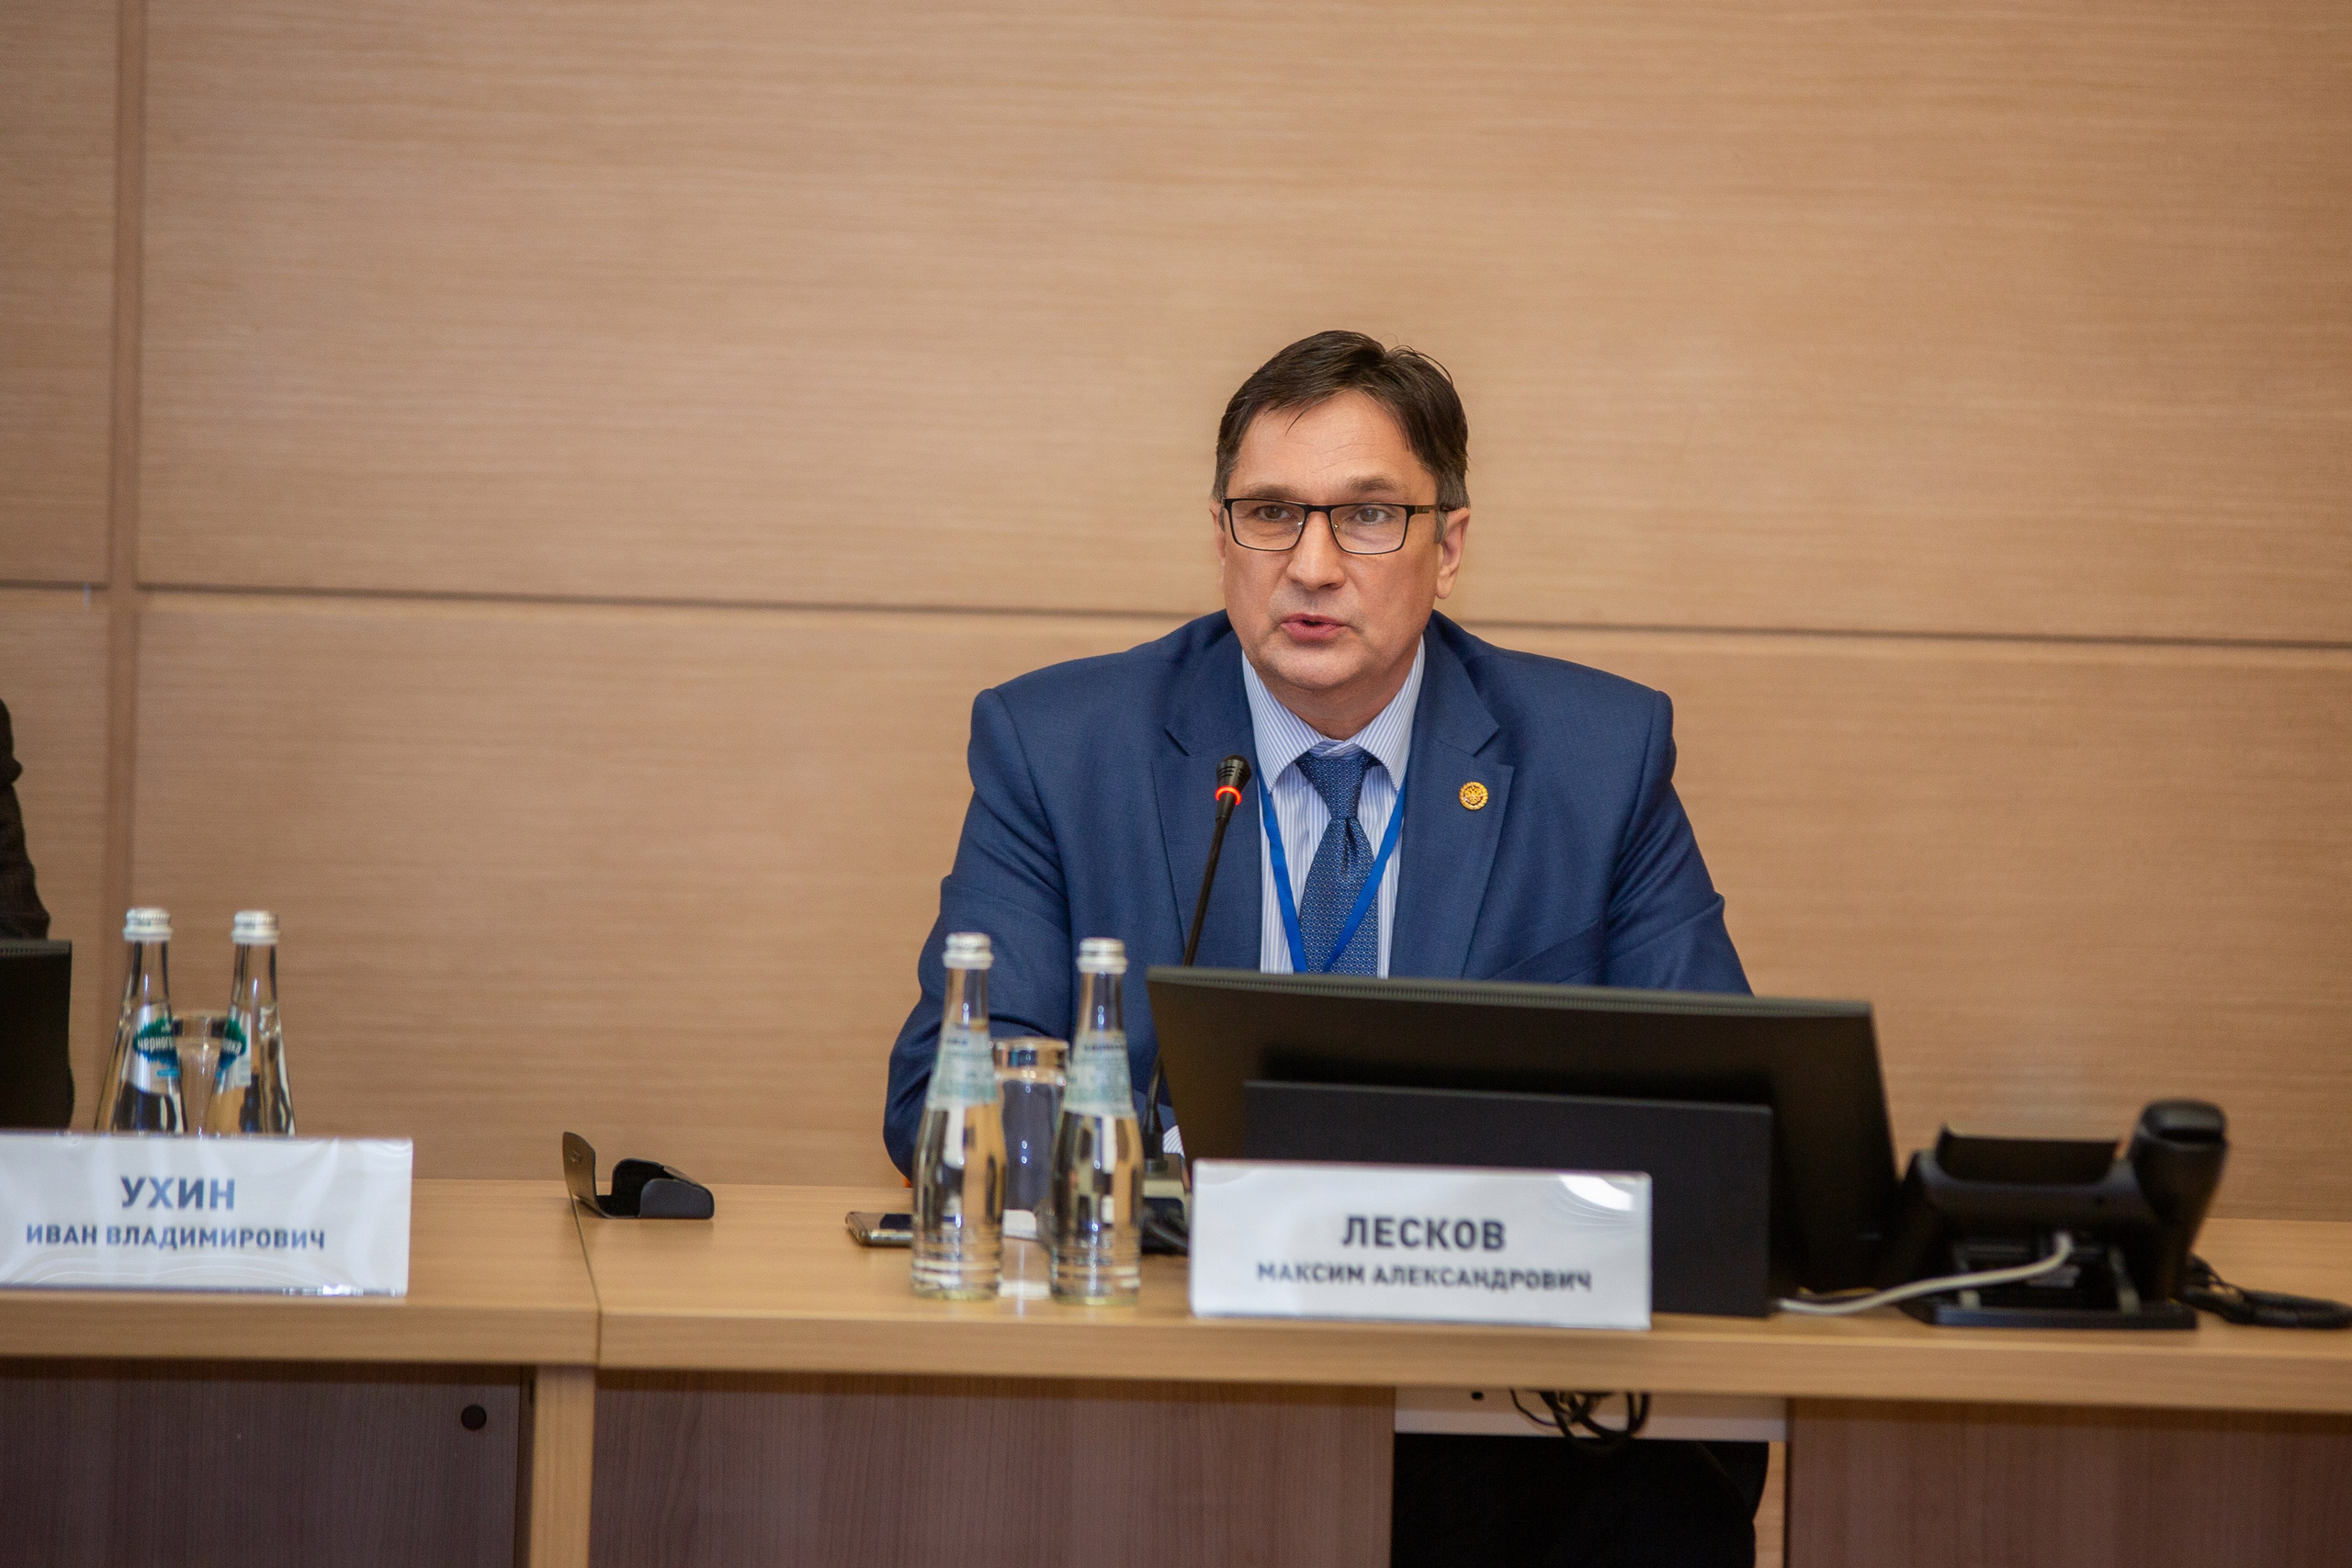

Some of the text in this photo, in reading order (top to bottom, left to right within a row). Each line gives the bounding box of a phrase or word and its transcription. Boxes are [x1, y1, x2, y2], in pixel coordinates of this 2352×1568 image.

[120, 1176, 235, 1211] УХИН
[26, 1224, 326, 1251] ИВАН ВЛАДИМИРОВИЧ
[1341, 1214, 1507, 1252] ЛЕСКОВ
[1257, 1262, 1592, 1292] МАКСИМ АЛЕКСАНДРОВИЧ
